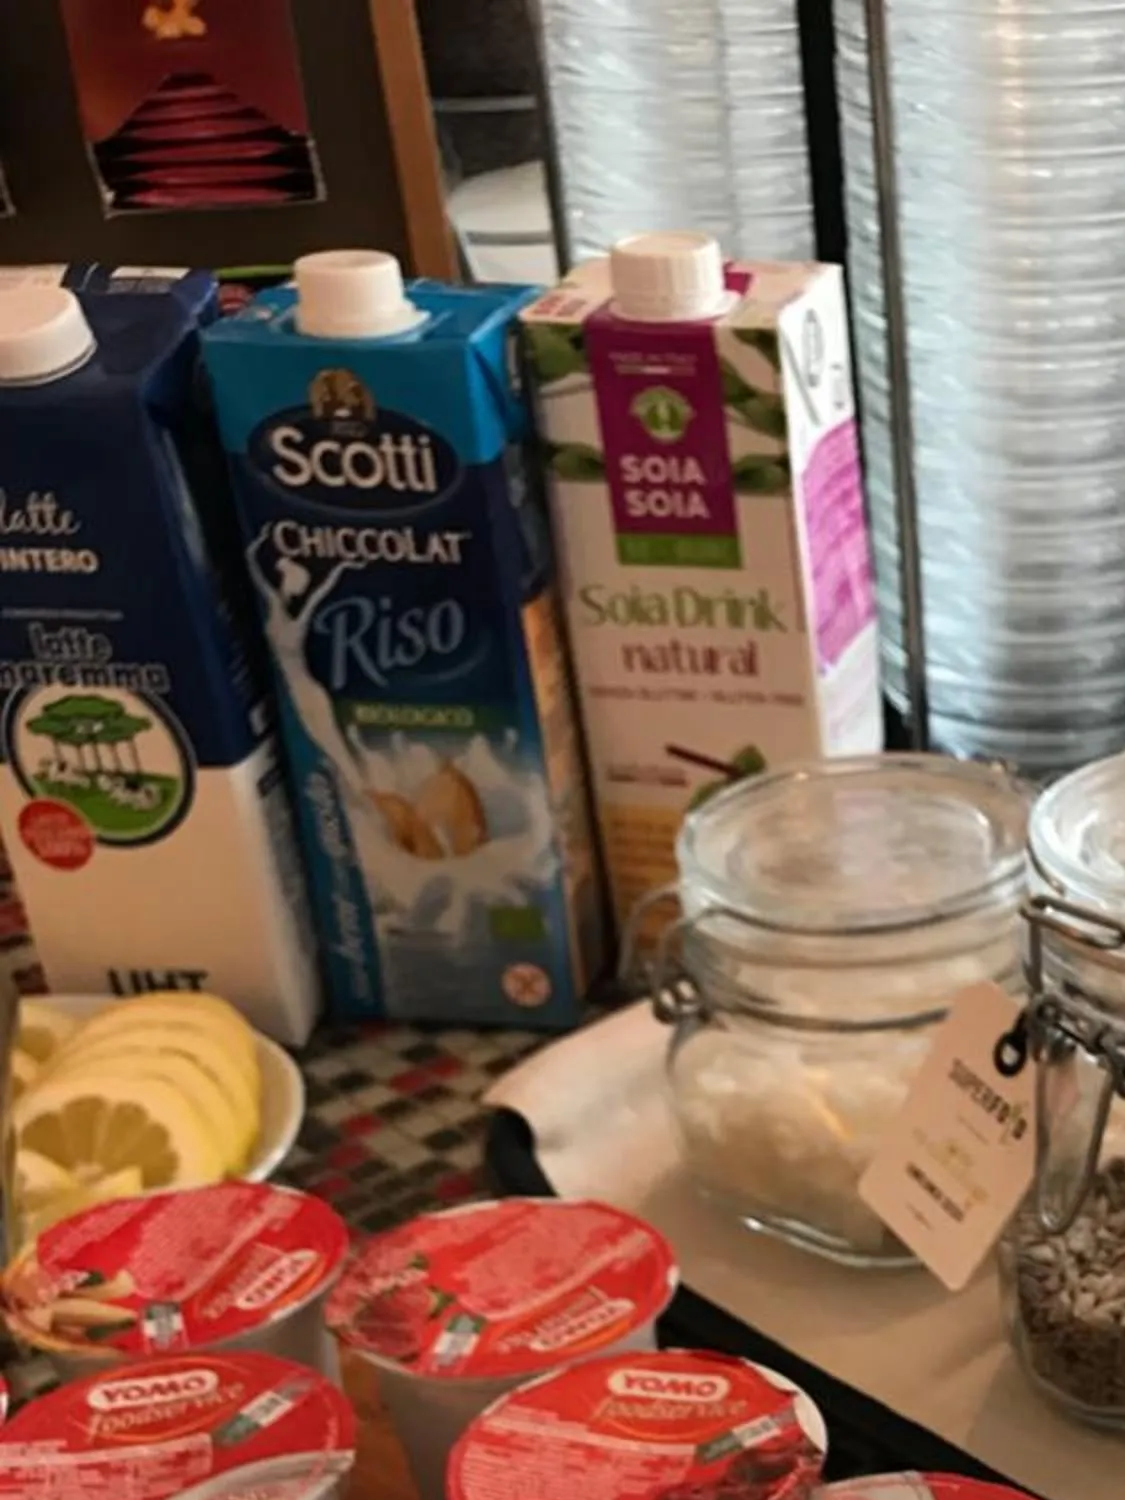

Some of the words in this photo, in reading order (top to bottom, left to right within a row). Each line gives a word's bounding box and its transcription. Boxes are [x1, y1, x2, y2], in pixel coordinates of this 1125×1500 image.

[271, 426, 437, 492] Scotti
[620, 454, 707, 484] SOIA
[625, 489, 712, 518] SOIA
[274, 520, 463, 564] CHICCOLAT
[313, 592, 464, 690] Riso
[621, 638, 758, 677] natural
